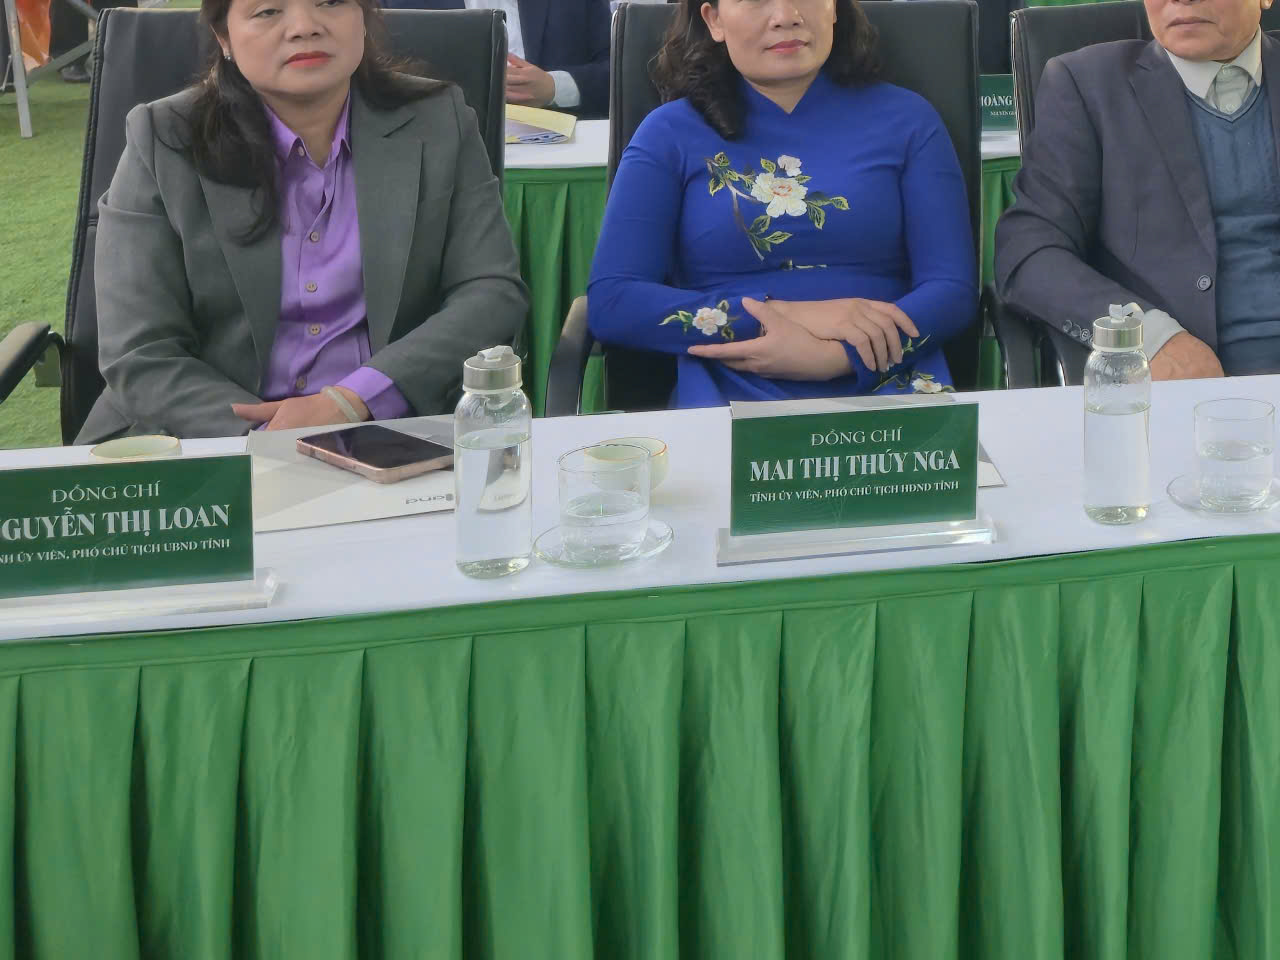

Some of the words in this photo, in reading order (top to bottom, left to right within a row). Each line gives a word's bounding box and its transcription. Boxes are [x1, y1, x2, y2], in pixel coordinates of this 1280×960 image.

[810, 428, 866, 446] ĐỒNG
[870, 426, 903, 443] CHÍ
[750, 458, 794, 481] MAI
[800, 456, 840, 482] THỊ
[845, 449, 908, 476] THÚY
[913, 449, 960, 472] NGA
[122, 480, 161, 499] CHÍ
[825, 486, 847, 498] PHÓ
[874, 483, 898, 496] TỊCH
[901, 482, 932, 494] HĐND
[0, 506, 96, 541] GUYỄN
[102, 510, 151, 537] THỊ
[158, 504, 230, 530] LOAN
[72, 546, 100, 559] PHÓ
[131, 543, 160, 556] TỊCH
[163, 541, 198, 553] UBND
